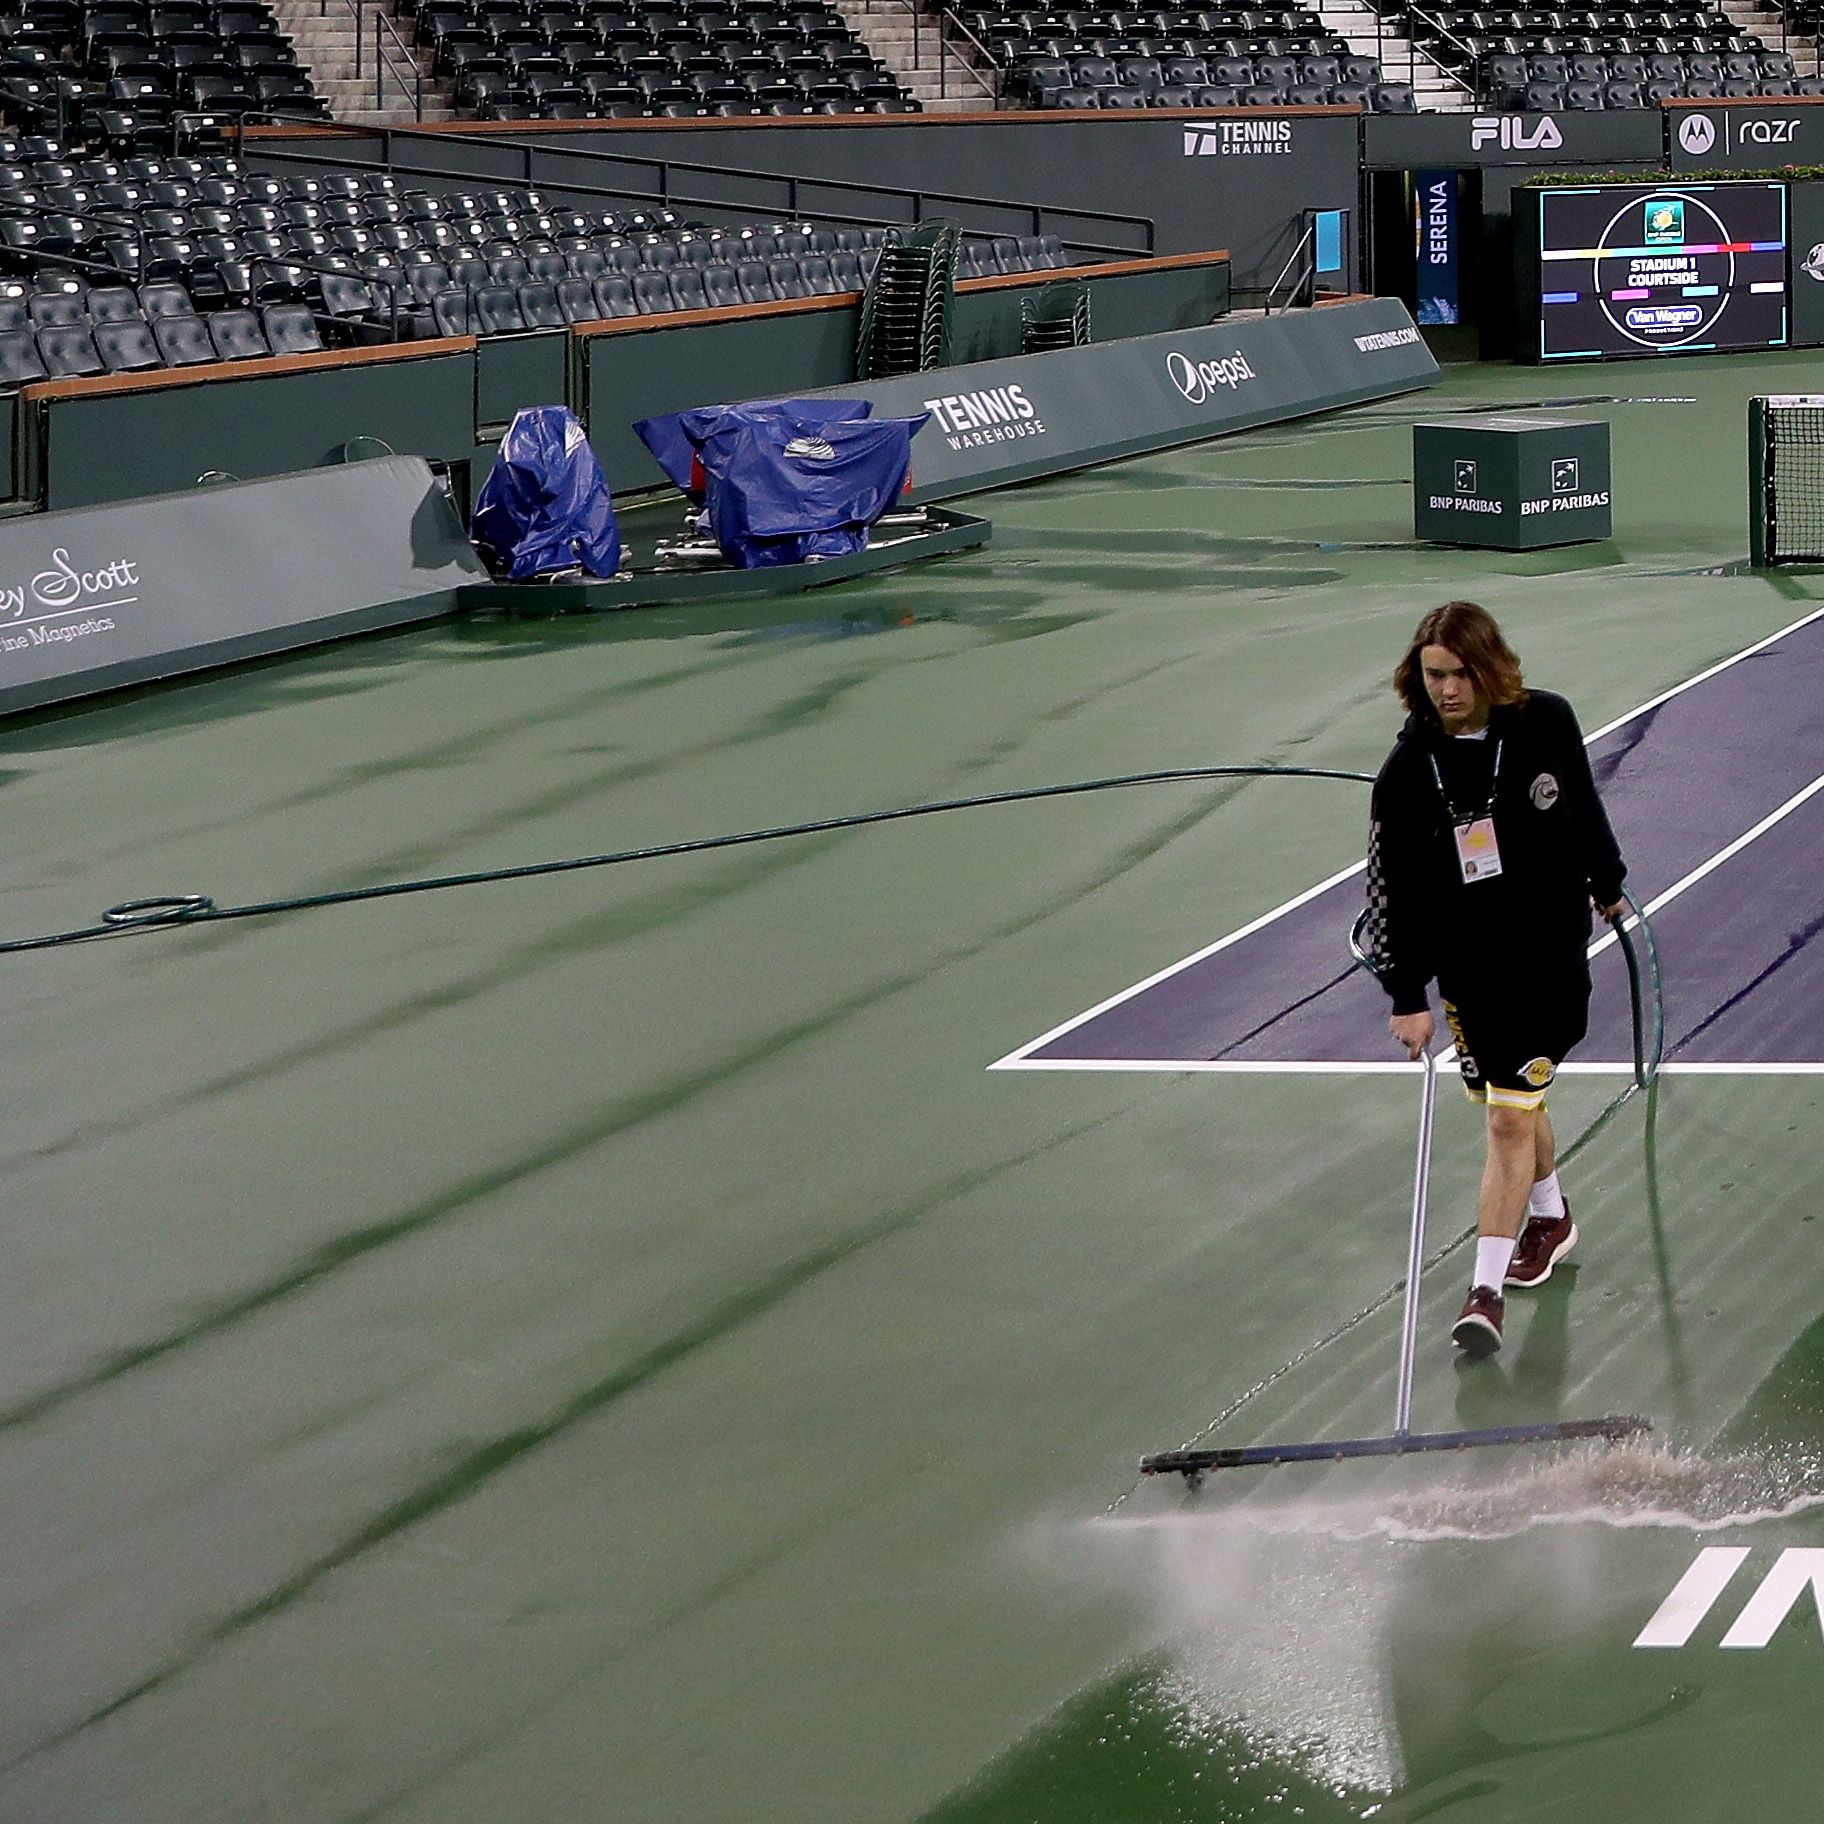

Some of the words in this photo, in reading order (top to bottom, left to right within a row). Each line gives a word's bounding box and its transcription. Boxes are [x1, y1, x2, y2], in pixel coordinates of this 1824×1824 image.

[1220, 120, 1292, 143] TENNIS
[1472, 116, 1563, 151] FILA
[1739, 119, 1801, 143] razr
[1221, 142, 1292, 155] CHANNEL
[1429, 180, 1447, 264] SERENA
[1631, 258, 1688, 272] STADIUM
[1689, 258, 1696, 270] 1
[1628, 271, 1699, 286] COURTSIDE
[1633, 311, 1654, 324] Van
[1656, 308, 1698, 325] Wagner
[1202, 349, 1256, 395] pepsi
[925, 384, 1035, 433] TENNIS
[947, 420, 1047, 452] WAREHOUSE
[1429, 496, 1454, 510] BNP
[1455, 497, 1502, 515] PARIBAS
[1520, 499, 1549, 516] BNP
[1552, 491, 1610, 512] PARIBAS
[31, 547, 140, 607] Scott
[0, 635, 30, 653] ine
[27, 617, 116, 643] Magnetics
